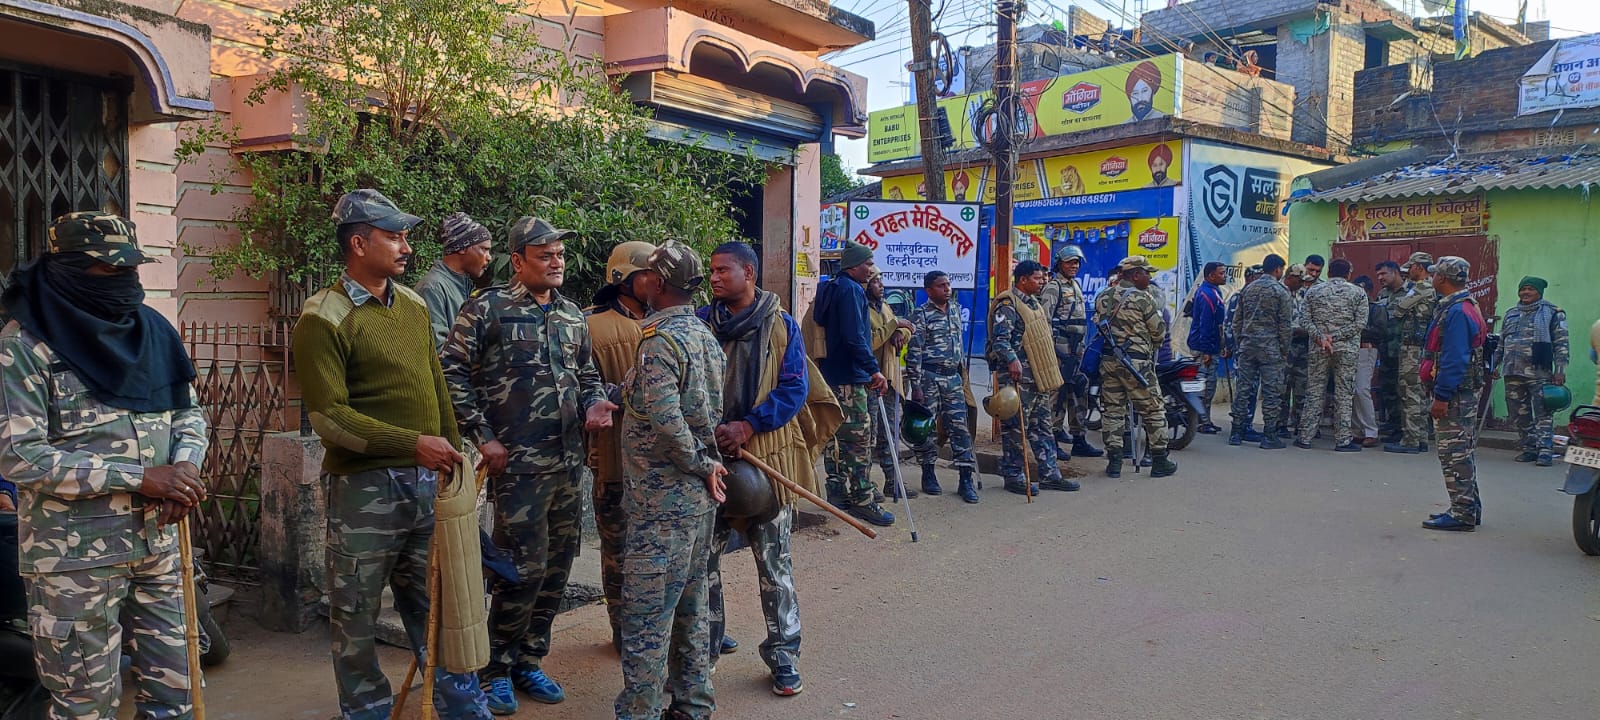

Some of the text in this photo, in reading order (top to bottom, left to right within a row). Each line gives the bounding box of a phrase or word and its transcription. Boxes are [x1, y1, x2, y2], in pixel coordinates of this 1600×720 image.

[884, 123, 900, 132] BABU
[873, 134, 911, 146] ENTERPRISES
[1406, 199, 1433, 217] वर्मा
[870, 210, 909, 238] राहत
